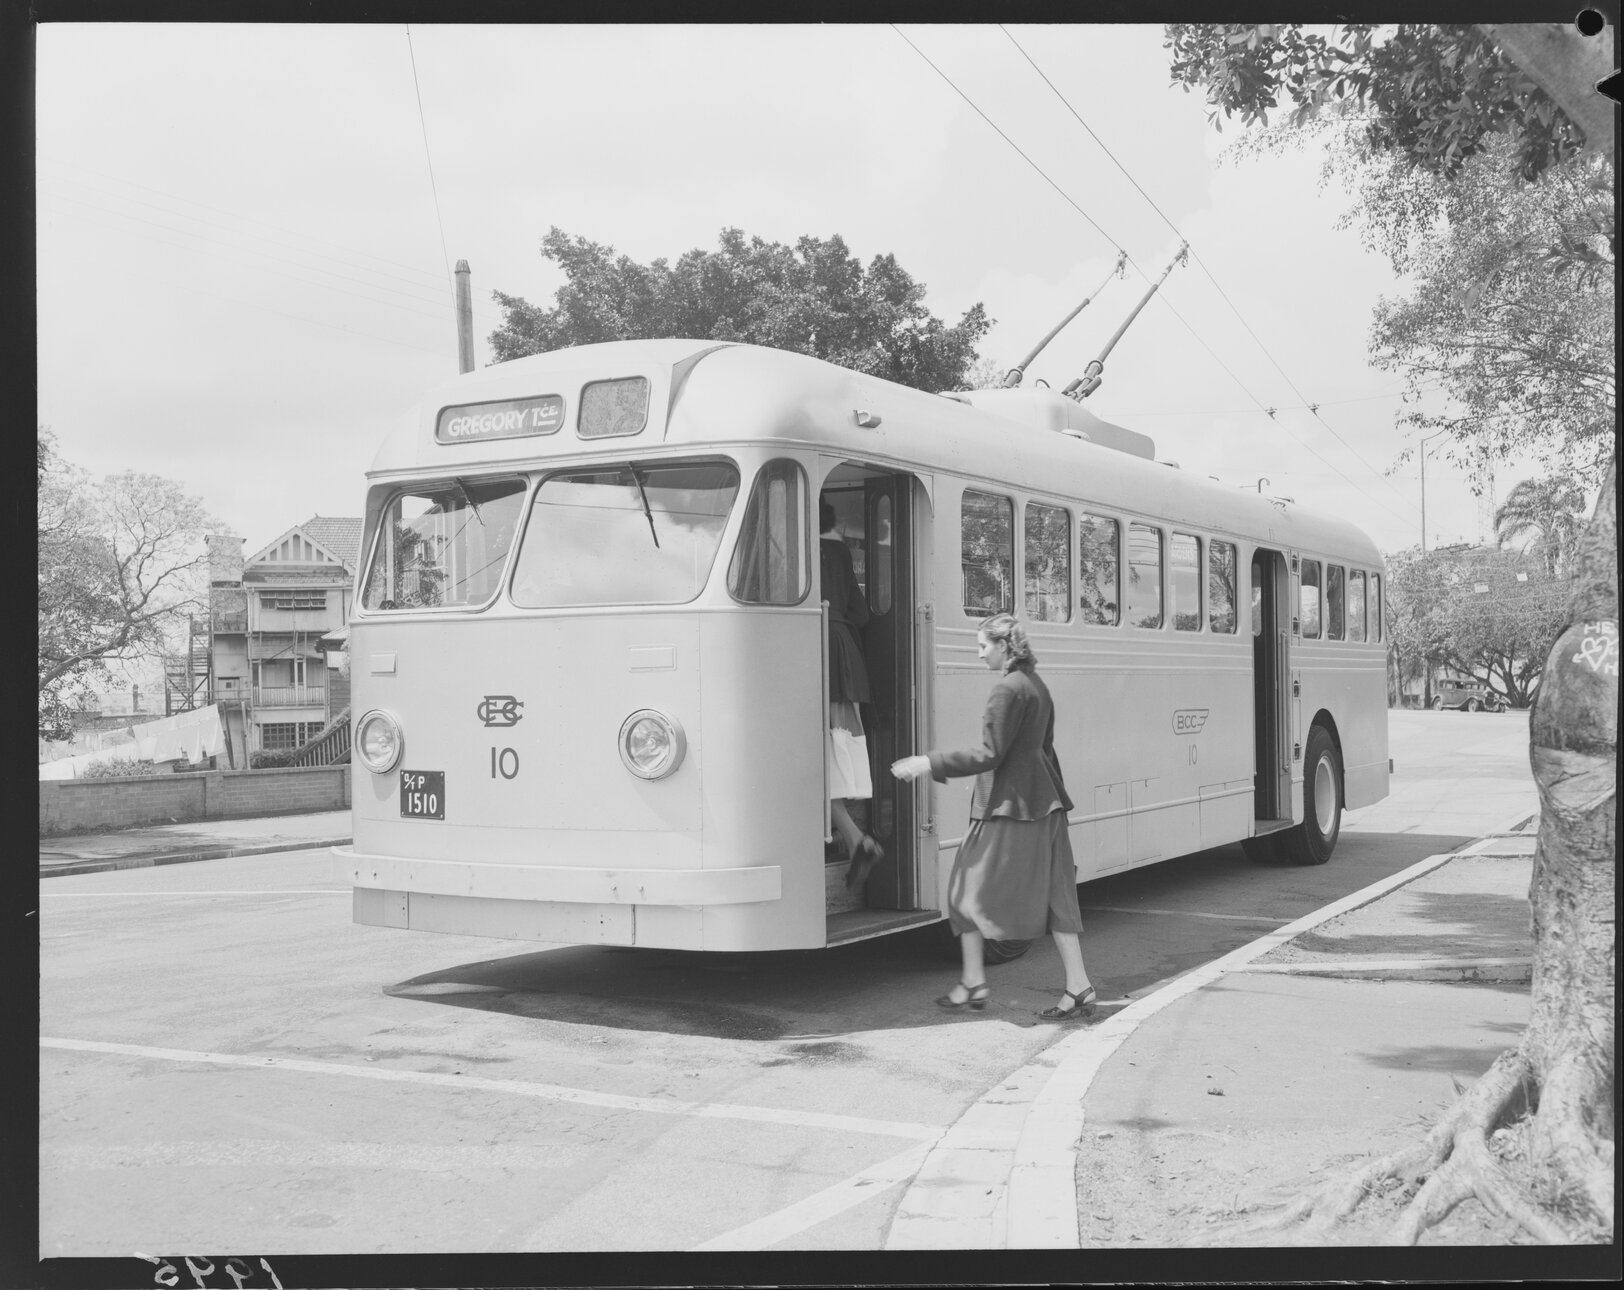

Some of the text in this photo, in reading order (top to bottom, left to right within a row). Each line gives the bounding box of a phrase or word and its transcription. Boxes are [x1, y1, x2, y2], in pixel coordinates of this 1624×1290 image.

[448, 408, 528, 437] GREGORY
[1177, 714, 1197, 729] BCC
[491, 747, 519, 779] 10
[1188, 744, 1198, 766] 10
[408, 792, 437, 814] 1510
